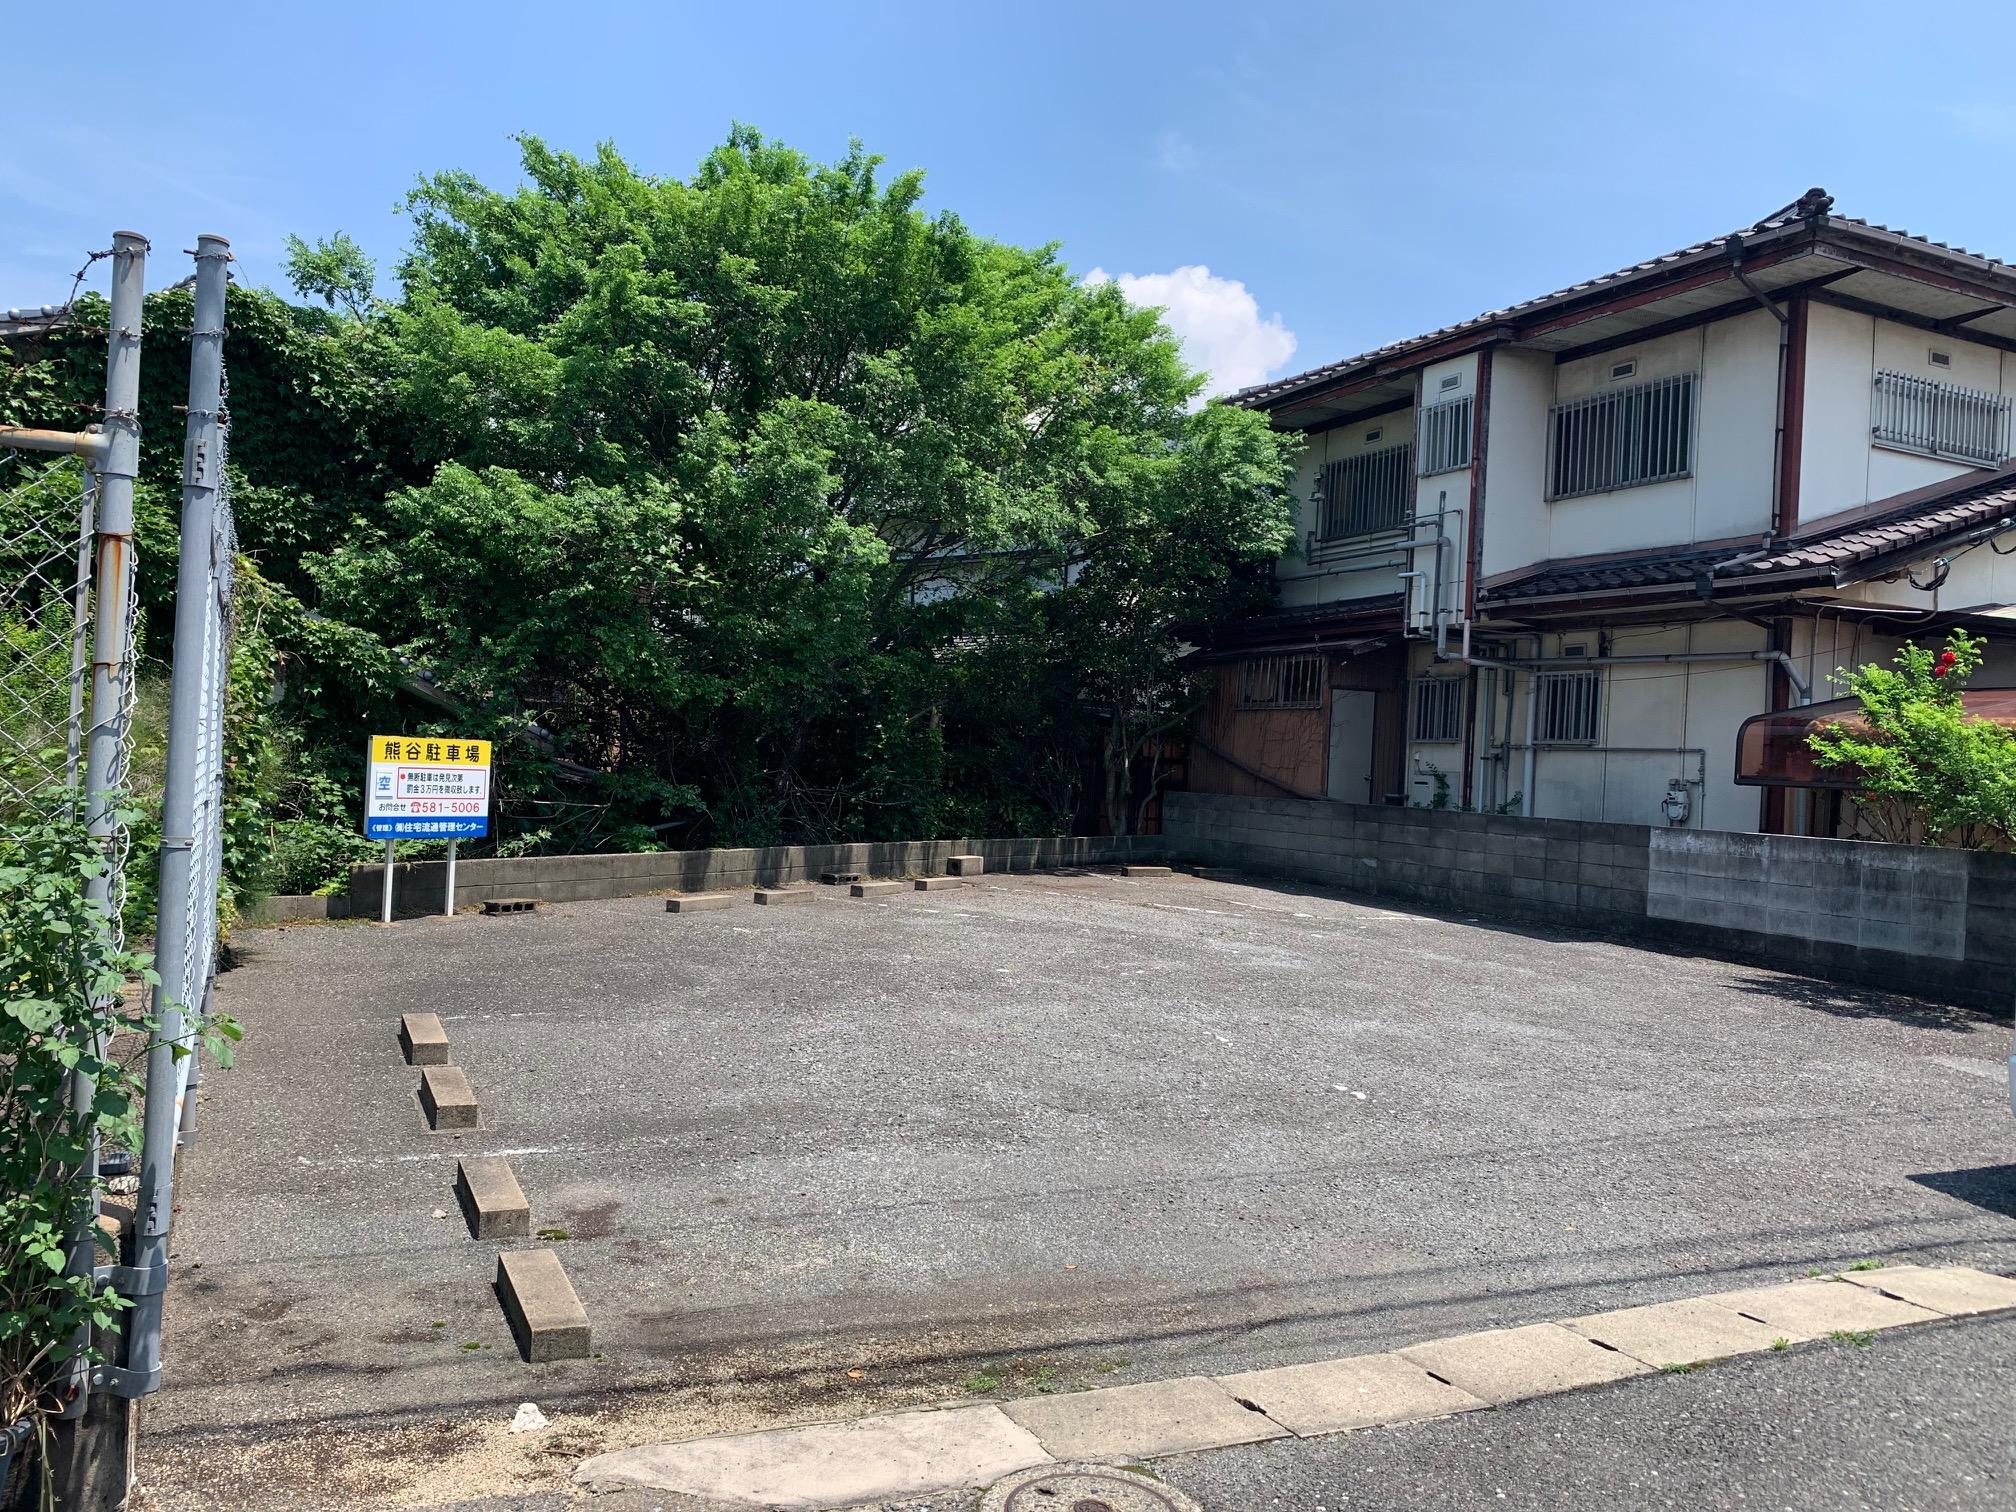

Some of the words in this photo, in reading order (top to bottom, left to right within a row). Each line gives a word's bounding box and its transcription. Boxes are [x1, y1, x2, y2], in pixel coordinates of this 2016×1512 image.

[384, 741, 480, 763] 熊谷駐車場
[378, 775, 391, 791] 空
[378, 803, 406, 812] お問合せ
